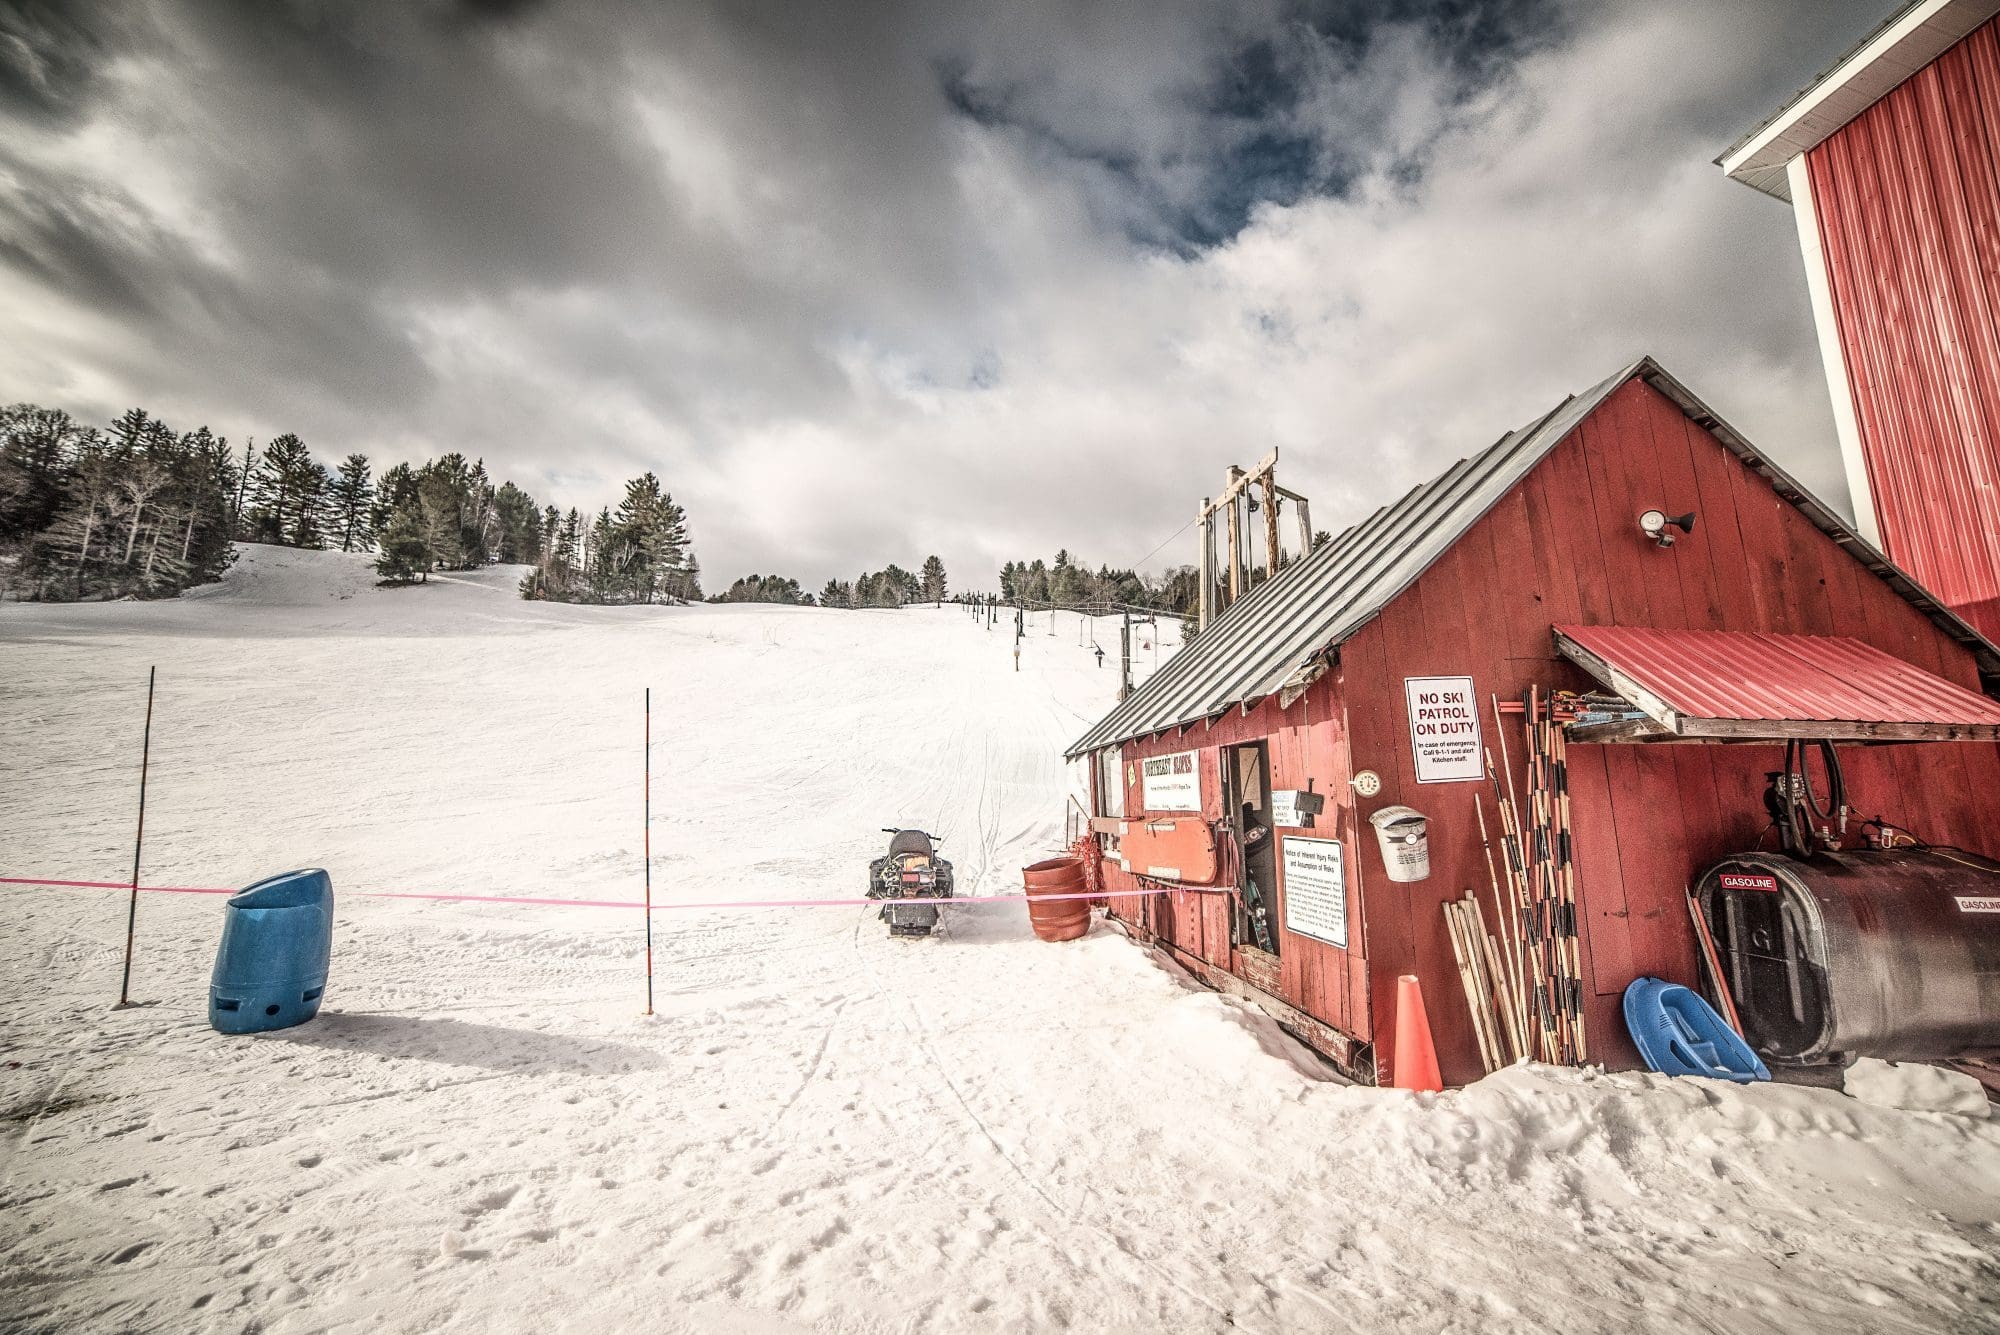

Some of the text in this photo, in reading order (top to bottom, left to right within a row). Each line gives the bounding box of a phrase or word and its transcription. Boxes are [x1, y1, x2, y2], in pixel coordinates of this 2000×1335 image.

[1419, 692, 1464, 704] NO SKI
[1419, 707, 1469, 719] PATROL
[1416, 722, 1474, 735] ON DUTY
[1285, 849, 1296, 857] Notice
[1301, 851, 1316, 859] Inherent
[1316, 852, 1327, 862] Injury
[1327, 854, 1339, 863] Risks
[1297, 860, 1318, 870] Assumption
[1724, 877, 1773, 888] GASOLINE
